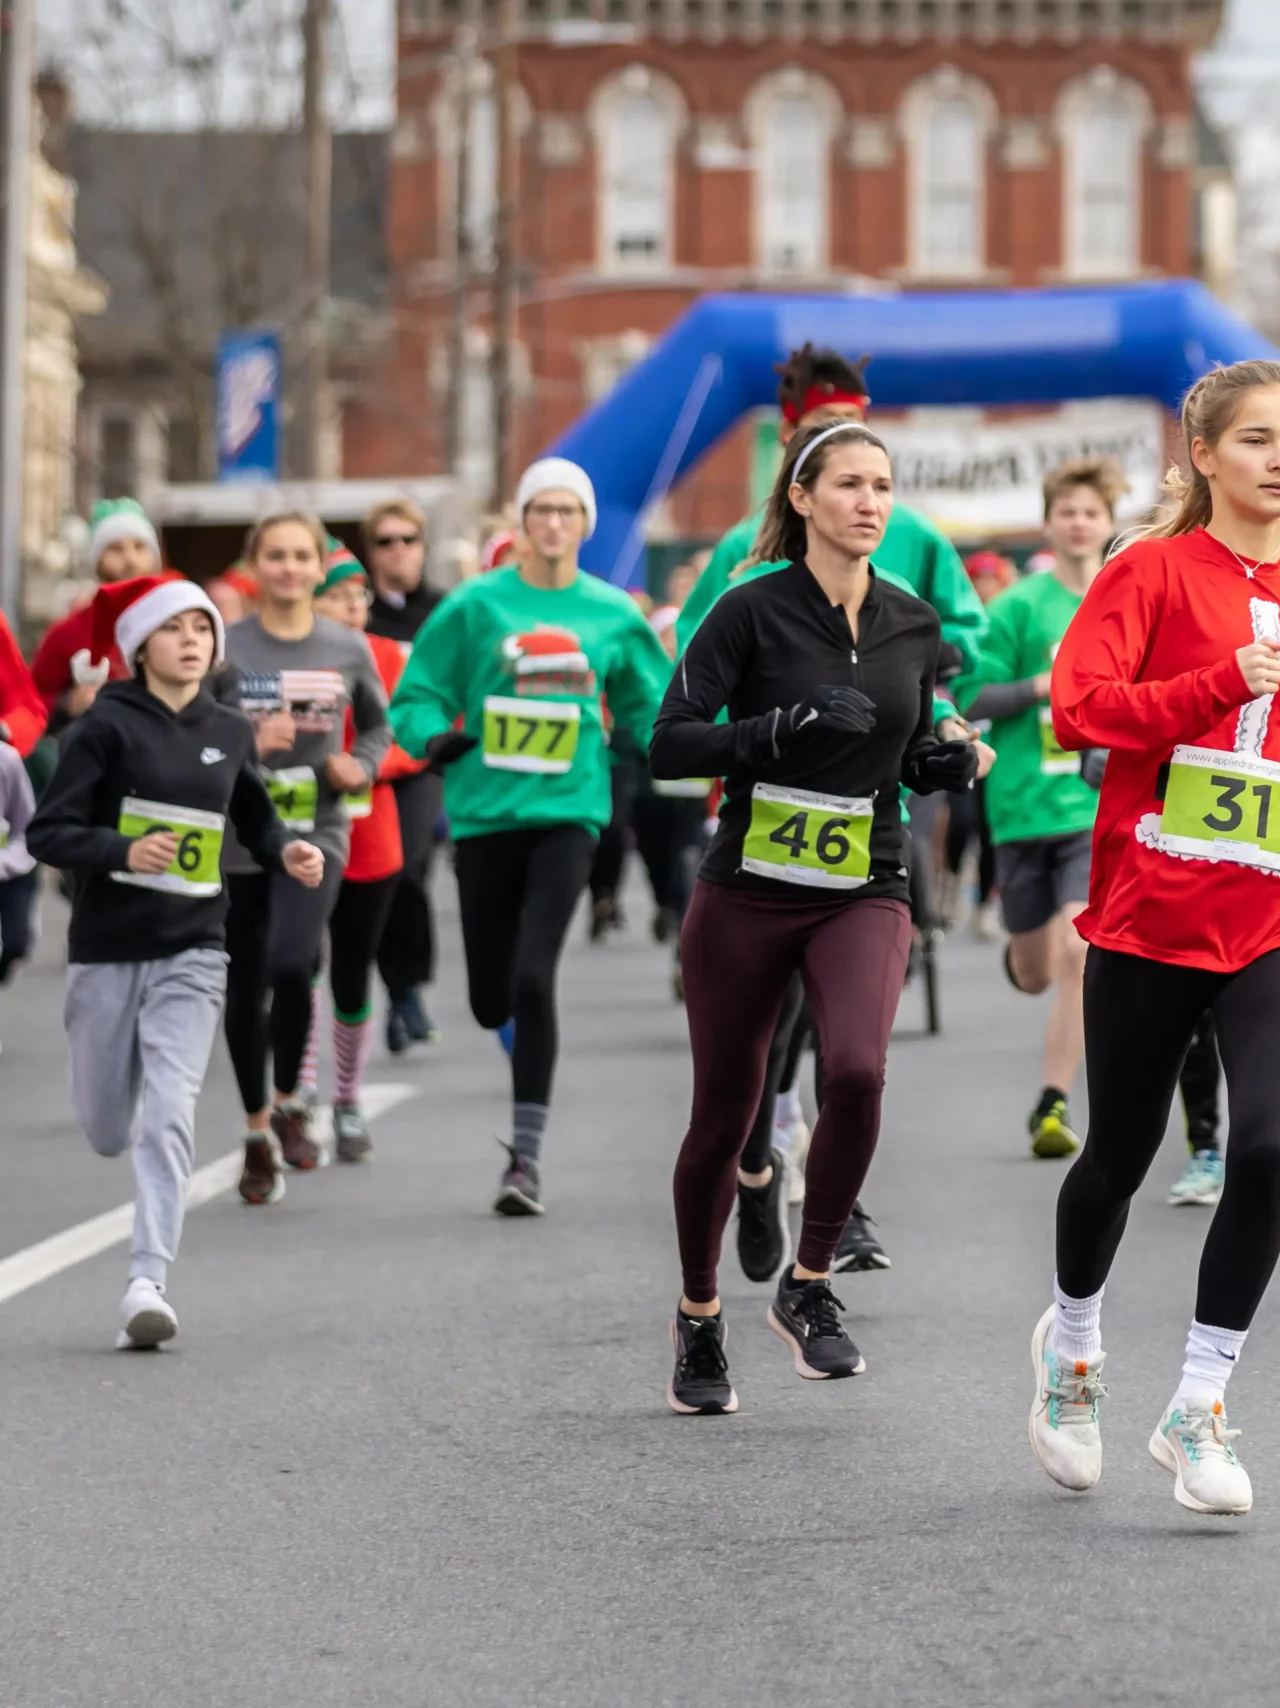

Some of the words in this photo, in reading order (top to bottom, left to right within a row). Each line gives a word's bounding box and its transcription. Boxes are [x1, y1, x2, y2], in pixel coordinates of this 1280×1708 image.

[495, 715, 569, 755] 177
[1202, 775, 1272, 839] 31
[145, 824, 204, 872] 6
[769, 811, 851, 866] 46
